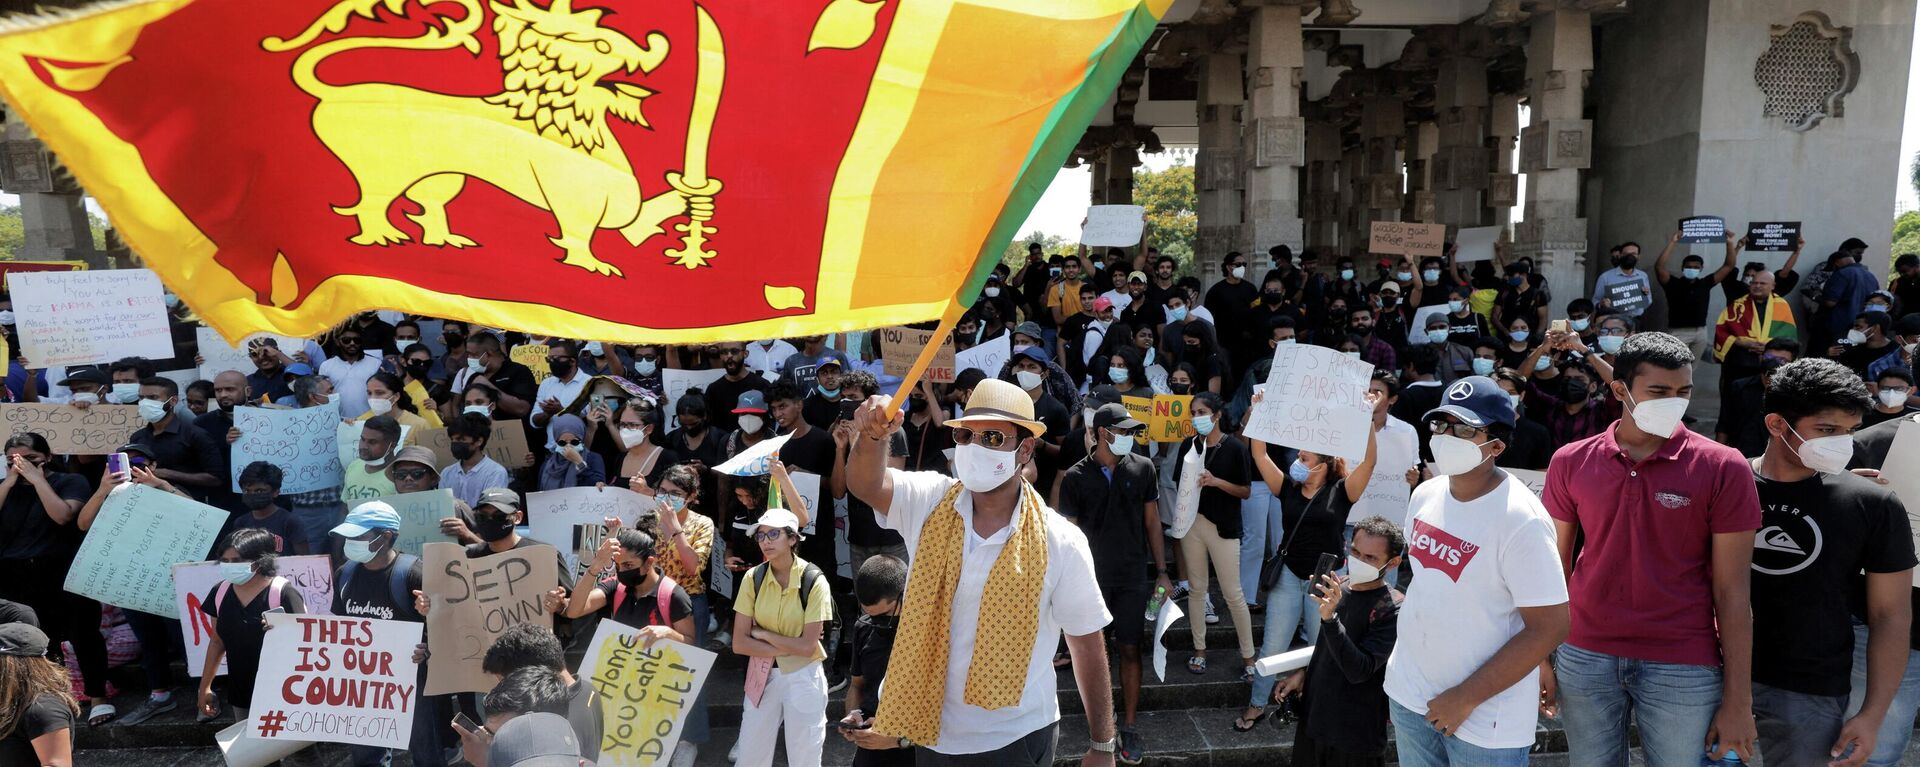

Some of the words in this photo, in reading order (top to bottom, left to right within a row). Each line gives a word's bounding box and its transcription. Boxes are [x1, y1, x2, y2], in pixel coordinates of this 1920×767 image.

[46, 275, 67, 293] truly
[73, 274, 92, 284] feel
[109, 275, 129, 286] sorry
[1611, 283, 1638, 294] ENOUGH
[51, 302, 95, 312] KARMA
[127, 296, 165, 307] BITCH
[882, 328, 902, 344] YOU
[1274, 345, 1319, 370] LET'S
[1266, 371, 1295, 396] THE
[1155, 400, 1183, 417] NO
[1258, 400, 1285, 417] OFF
[1290, 403, 1330, 425] OUR
[1254, 420, 1343, 447] PARADISE
[199, 509, 208, 519] TO
[1761, 504, 1801, 516] VER
[100, 538, 113, 557] OUR
[83, 560, 105, 595] SECURE
[147, 571, 164, 595] NEED
[164, 603, 174, 614] TO
[191, 528, 211, 559] IMPACT
[345, 598, 394, 620] kindness
[296, 618, 373, 647] THIS
[294, 647, 331, 672] IS
[343, 648, 395, 677] OUR
[591, 633, 638, 700] Home
[281, 675, 415, 714] COUNTRY
[257, 709, 399, 742] #GOHOMEGOTA
[637, 719, 674, 761] Do
